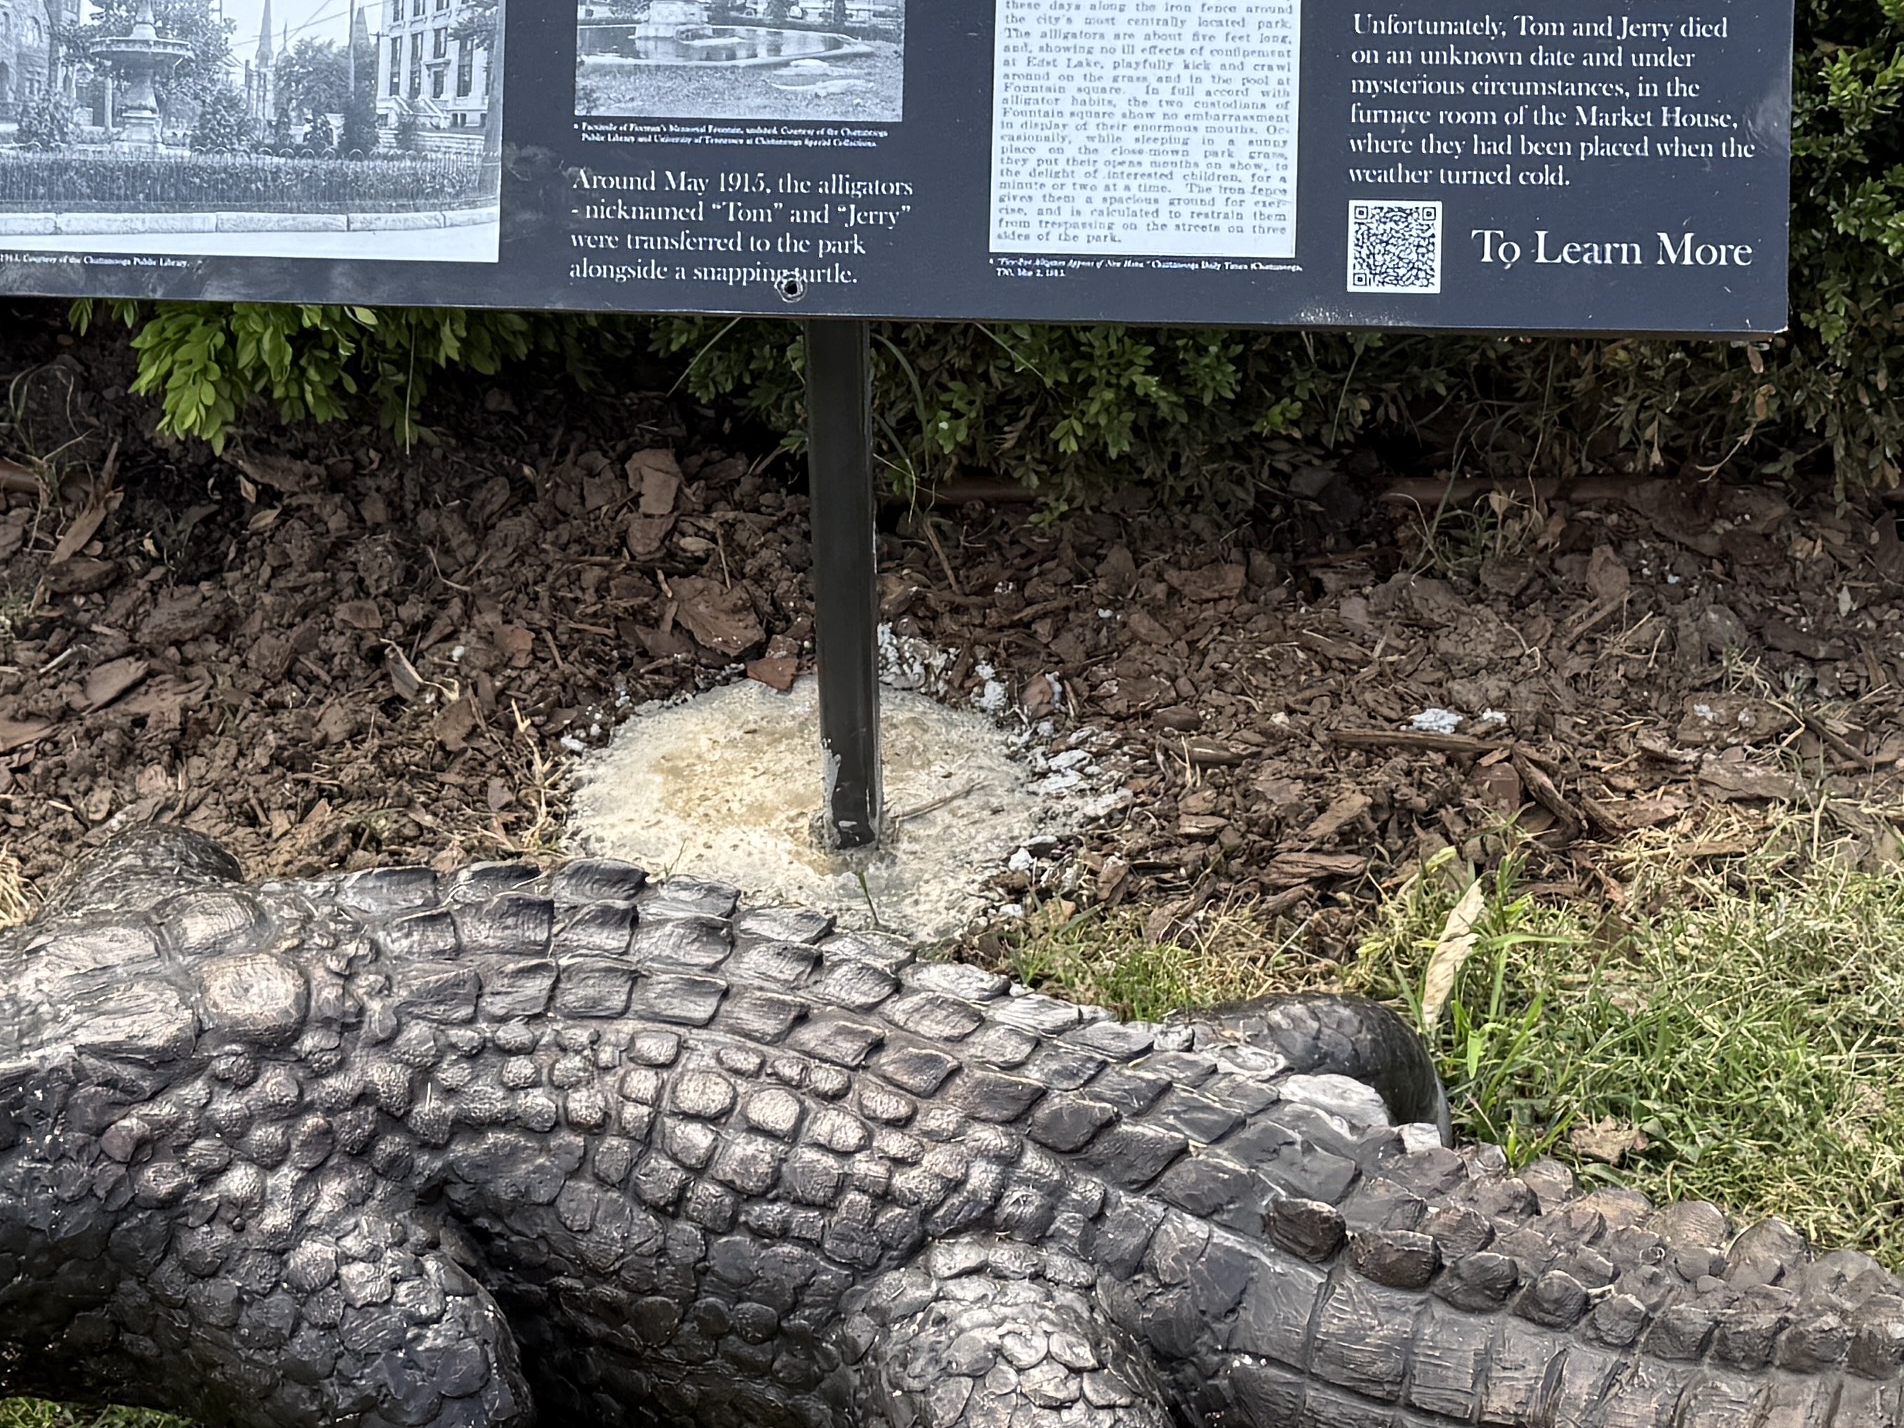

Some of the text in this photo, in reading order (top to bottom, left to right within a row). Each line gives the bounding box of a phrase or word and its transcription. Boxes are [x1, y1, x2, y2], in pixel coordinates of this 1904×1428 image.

[1354, 13, 1727, 42] Unfortunately, Tom and Jerry died
[1352, 44, 1695, 67] on an unknown date and under
[1352, 74, 1700, 99] mysterious circumstances, in the
[1351, 103, 1737, 129] furnace room of the Market House,
[1349, 132, 1755, 161] where they had been placed when the
[572, 169, 913, 198] Around May 1915, the alligators
[1349, 163, 1570, 186] weather turned cold.
[586, 198, 703, 221] nicknamed
[712, 201, 783, 222] "Tom"
[790, 203, 829, 223] and
[838, 204, 911, 229] "Jerry"
[571, 230, 866, 258] were transferred to the park
[1471, 230, 1752, 266] To Learn More
[570, 257, 667, 282] alongside
[675, 267, 686, 280] a
